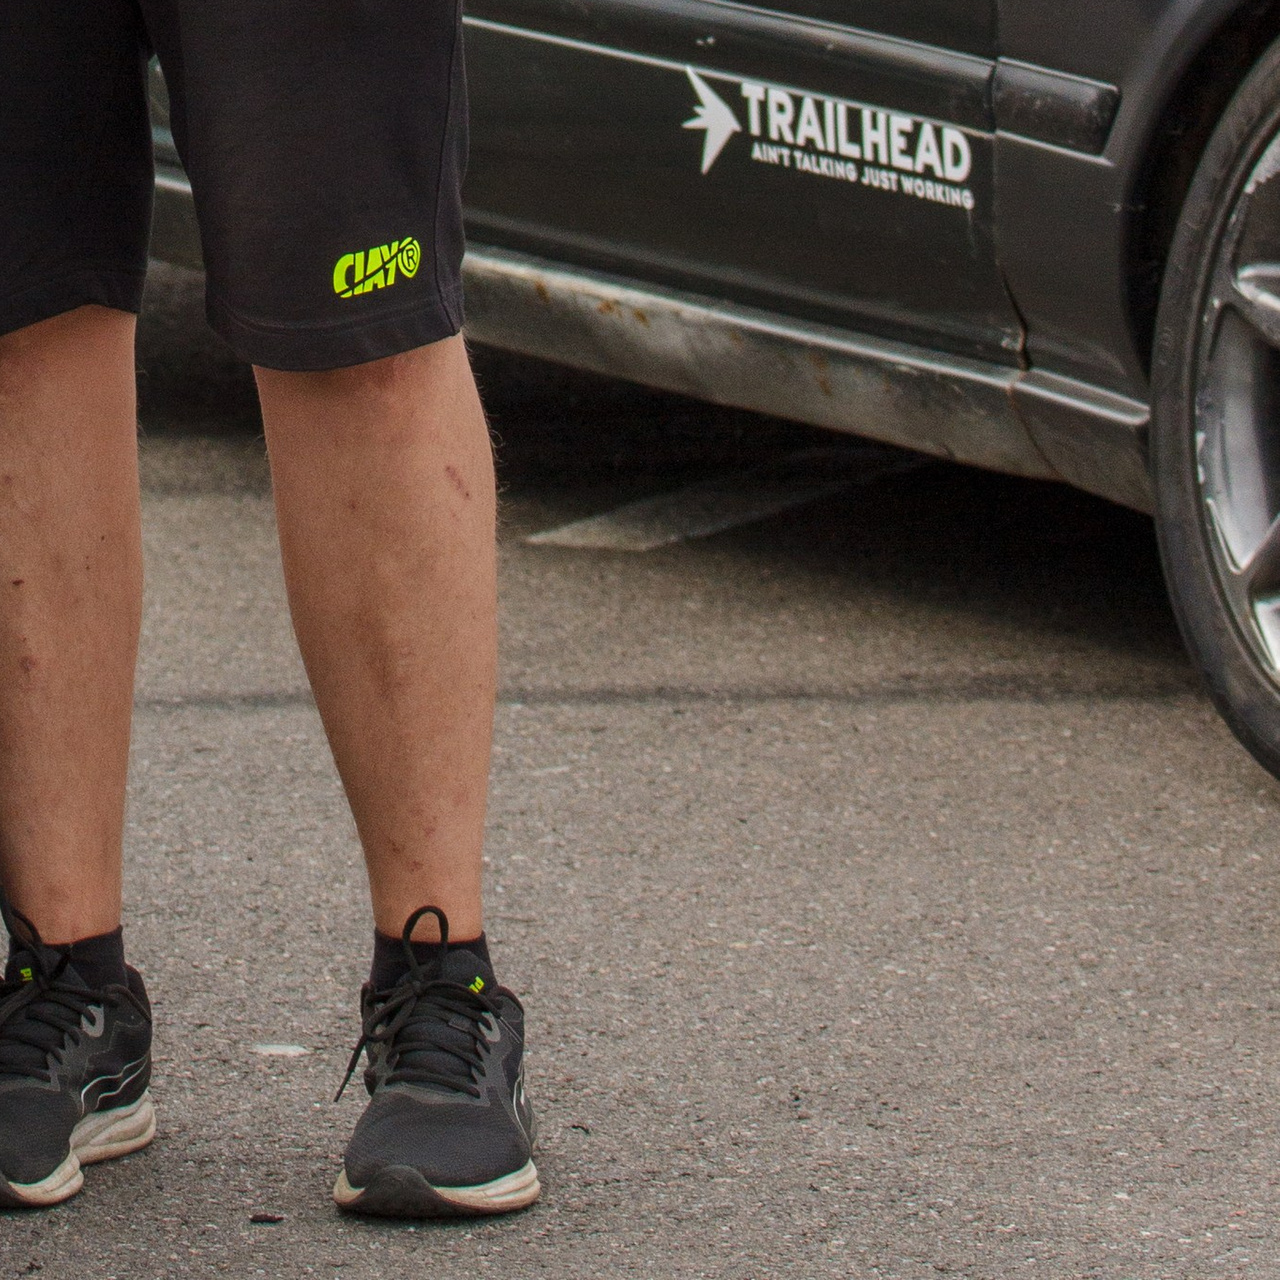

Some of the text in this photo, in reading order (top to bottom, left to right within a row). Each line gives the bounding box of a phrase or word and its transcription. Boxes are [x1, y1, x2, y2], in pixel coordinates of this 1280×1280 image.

[740, 82, 972, 182] TRAILHEAD
[751, 142, 976, 210] AIN'T TALKING JUST WORKING
